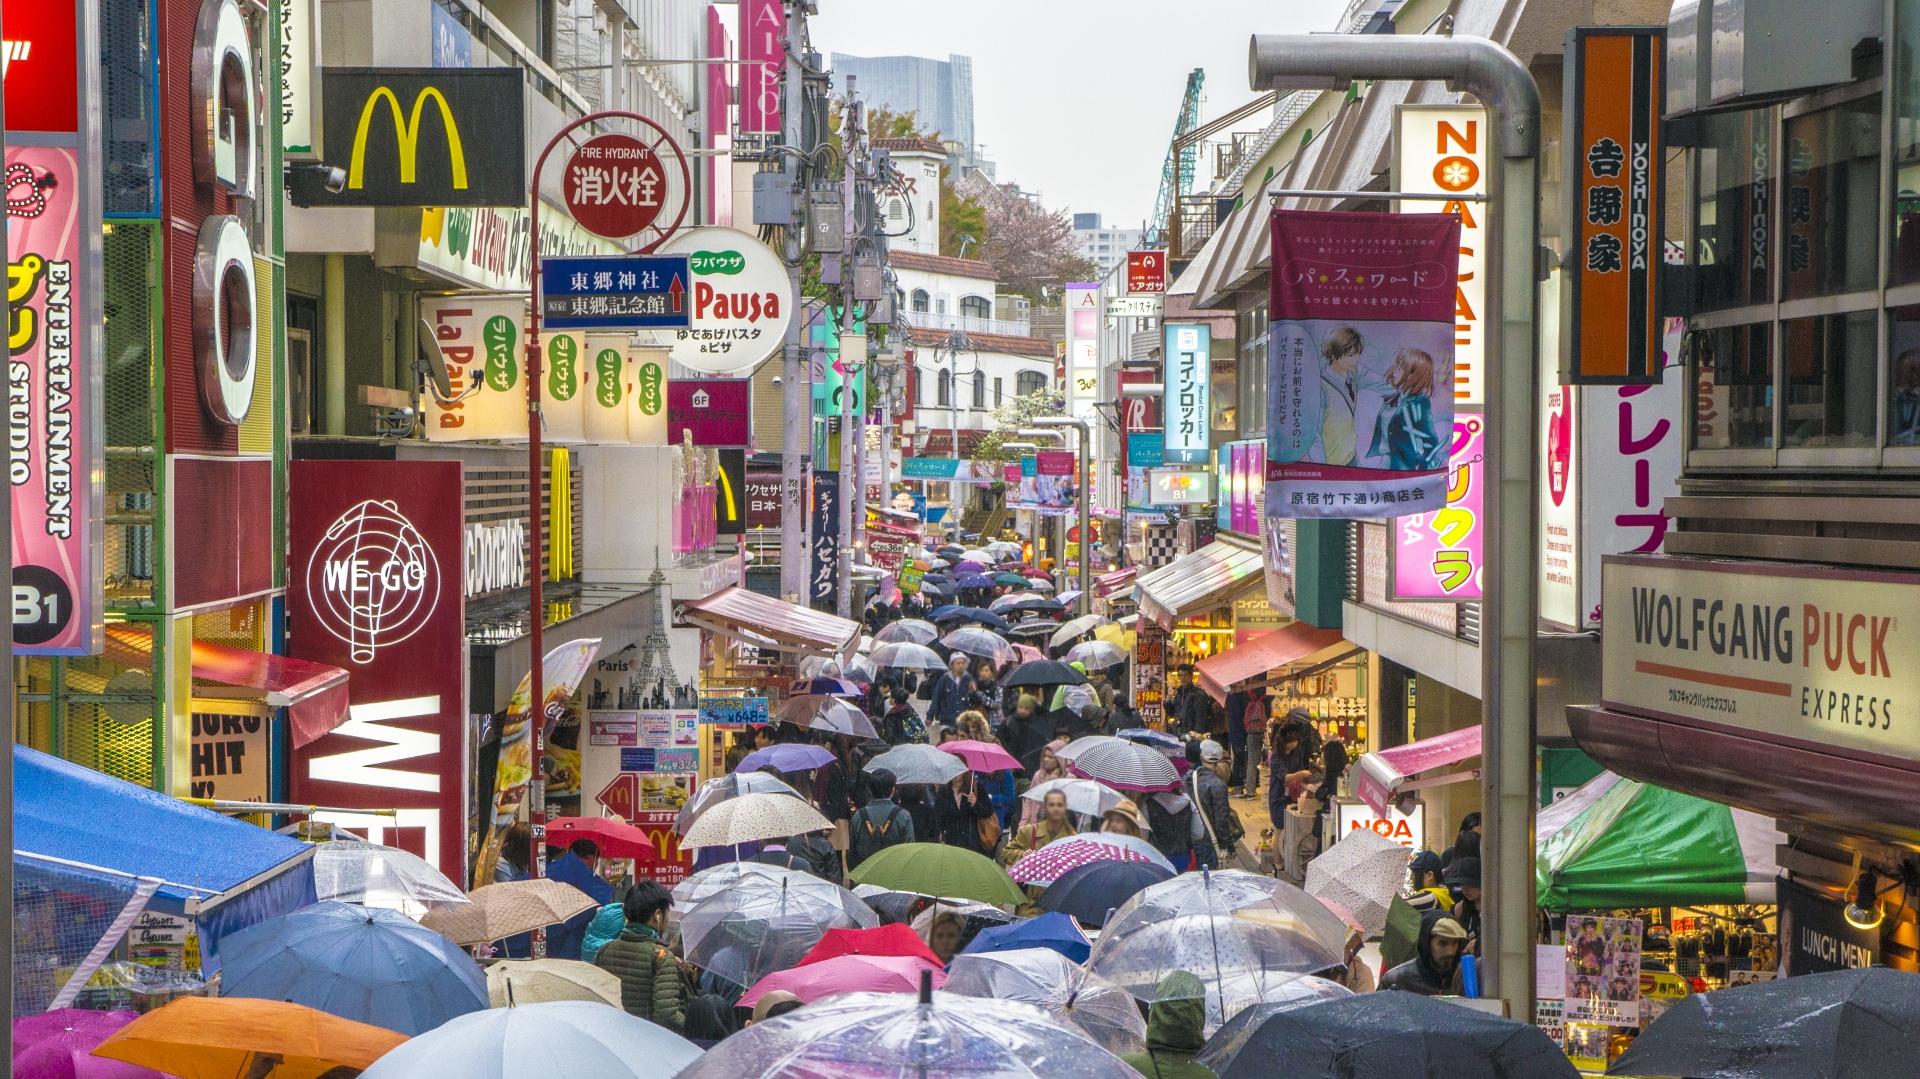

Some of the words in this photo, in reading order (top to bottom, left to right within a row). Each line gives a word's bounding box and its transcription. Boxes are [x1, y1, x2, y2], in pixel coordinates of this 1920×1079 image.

[581, 147, 601, 160] FIRE
[605, 148, 650, 161] HYDRANT
[573, 166, 660, 207] 消火栓
[1587, 137, 1625, 274] 吉野家
[1631, 142, 1648, 270] YOSHINOYA
[691, 256, 743, 269] ラパウザ
[571, 295, 665, 316] 東郷記念館
[695, 281, 779, 324] Pausa
[492, 319, 510, 390] ラパウザ
[676, 328, 761, 341] ゆであげパスタ
[700, 342, 732, 353] &ピザ
[556, 337, 570, 400] ラパウザ
[603, 350, 616, 408] ラパウザ
[645, 363, 657, 415] ラパウザ
[1279, 335, 1289, 425] パスワードだけだぜ
[47, 260, 72, 539] ENTERTAINMENT
[694, 395, 707, 406] 6F
[1179, 352, 1195, 447] コインロッカー
[1292, 337, 1304, 449] 本当にお前を守れるのは
[1181, 450, 1192, 461] 1F
[1173, 490, 1187, 500] B1
[1291, 487, 1424, 506] 原宿竹下通り商店会
[1553, 474, 1563, 493] BOX
[820, 490, 833, 533] ギャラリー
[465, 518, 525, 598] cDonald's
[814, 535, 836, 598] ハセガワ
[12, 582, 58, 625] B1
[1632, 586, 1794, 665] WOLFGANG
[1802, 603, 1892, 679] PUCK
[598, 659, 628, 671] Paris
[1139, 708, 1160, 716] SALE
[1800, 686, 1892, 731] EXPRESS
[1802, 926, 1837, 963] LUNCH
[1658, 982, 1685, 996] 専門店
[1537, 1018, 1559, 1026] おしらせ
